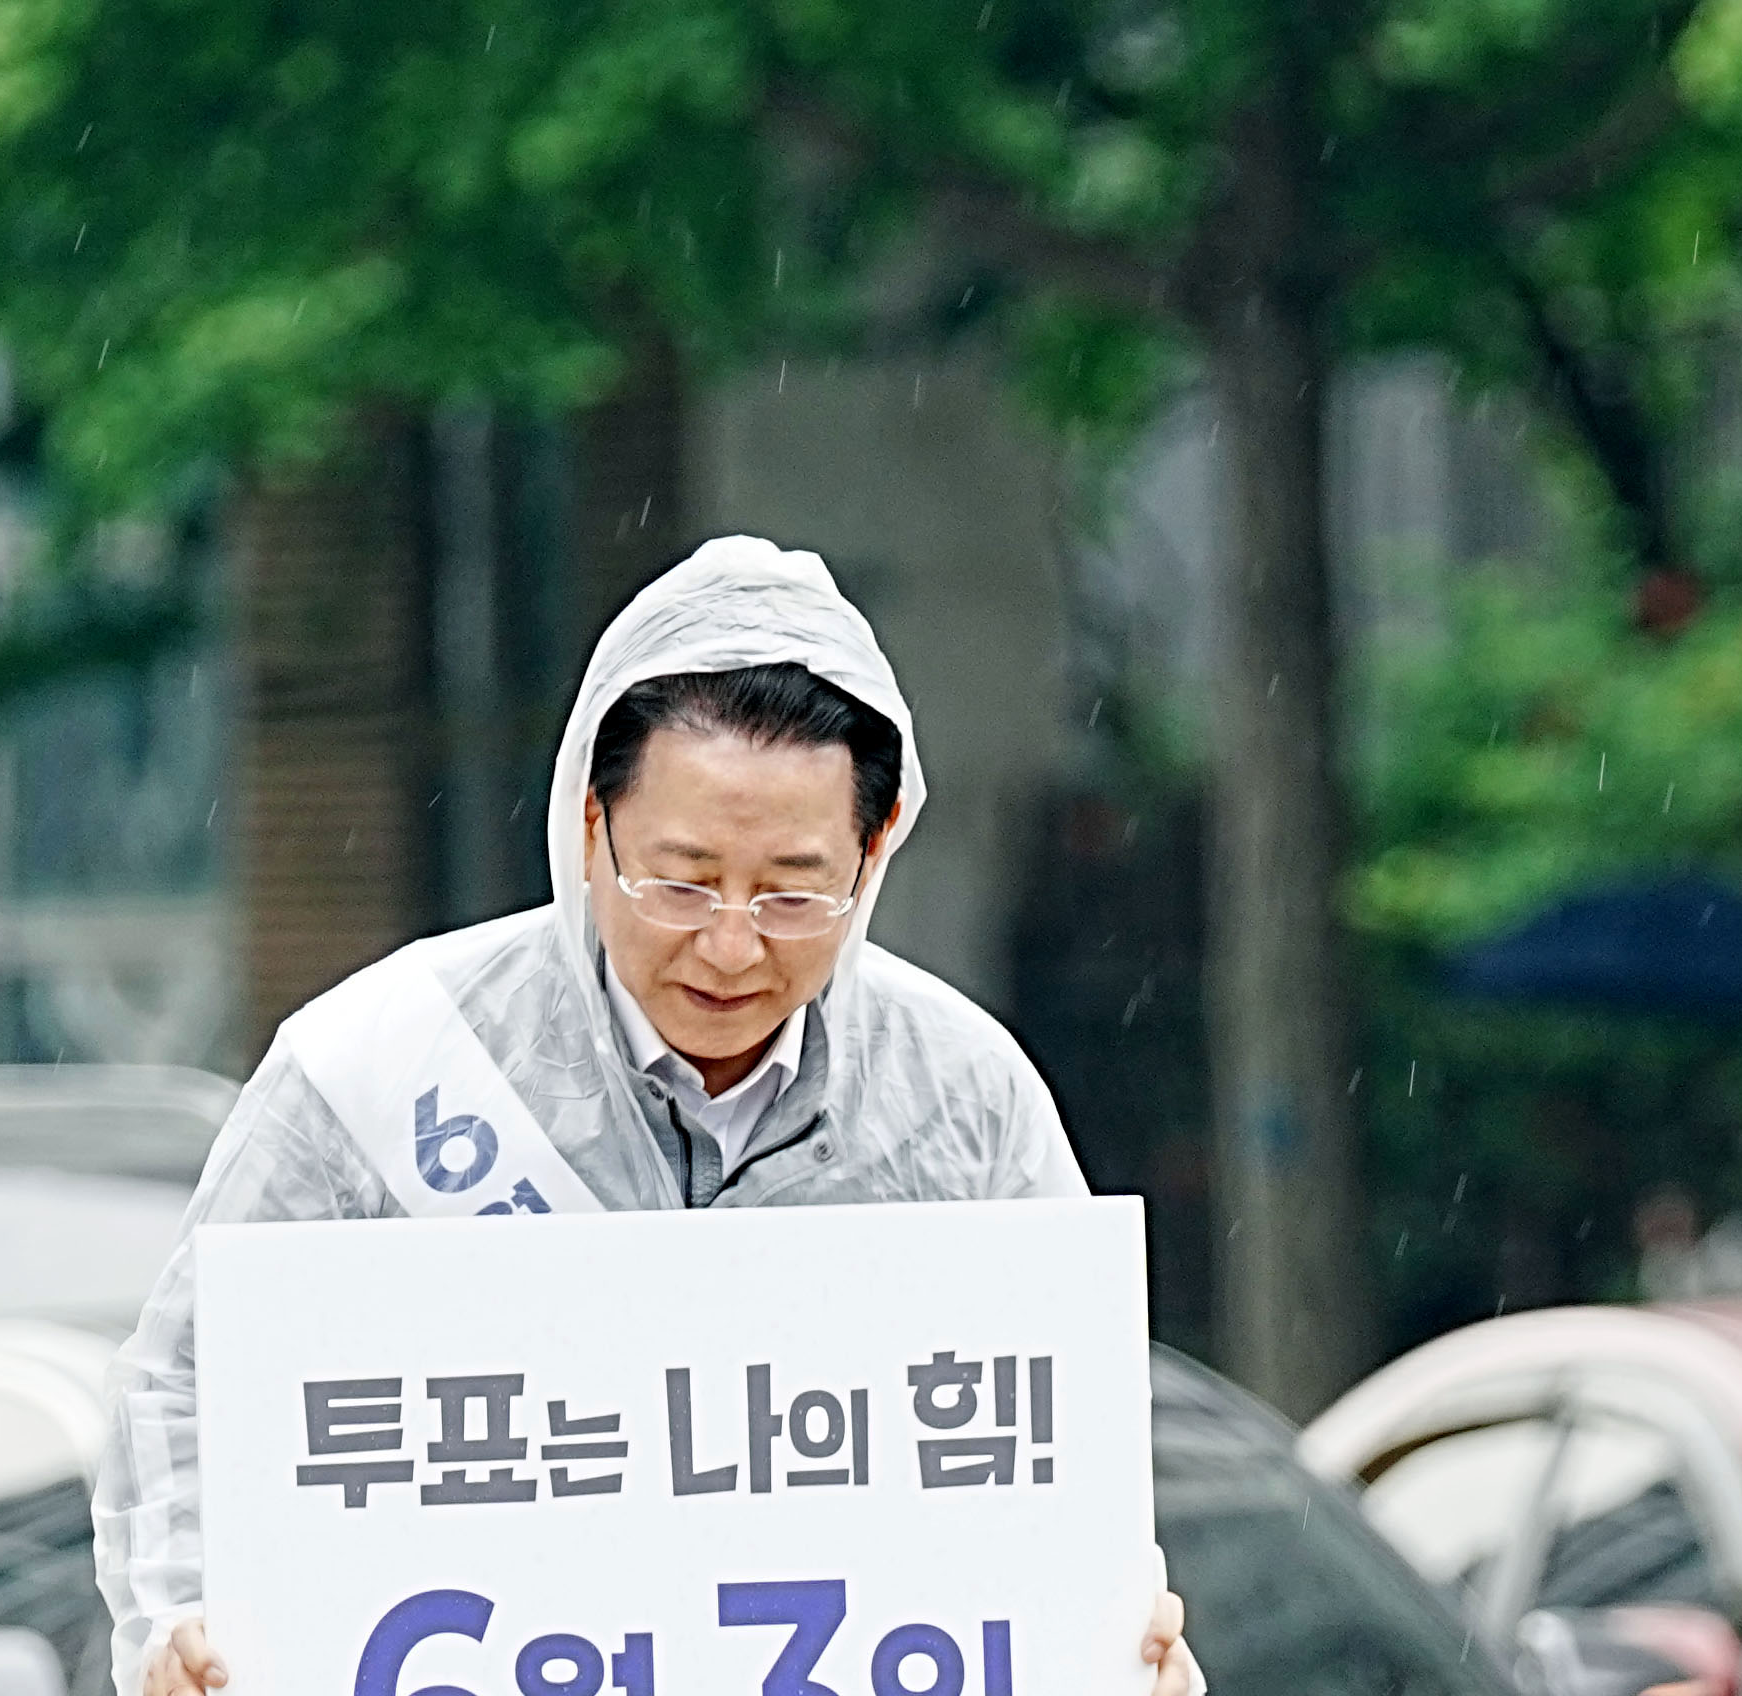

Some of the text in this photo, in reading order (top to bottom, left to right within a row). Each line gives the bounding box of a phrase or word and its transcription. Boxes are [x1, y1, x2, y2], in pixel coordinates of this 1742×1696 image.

[296, 1351, 1053, 1508] 투표는 나의 힘!
